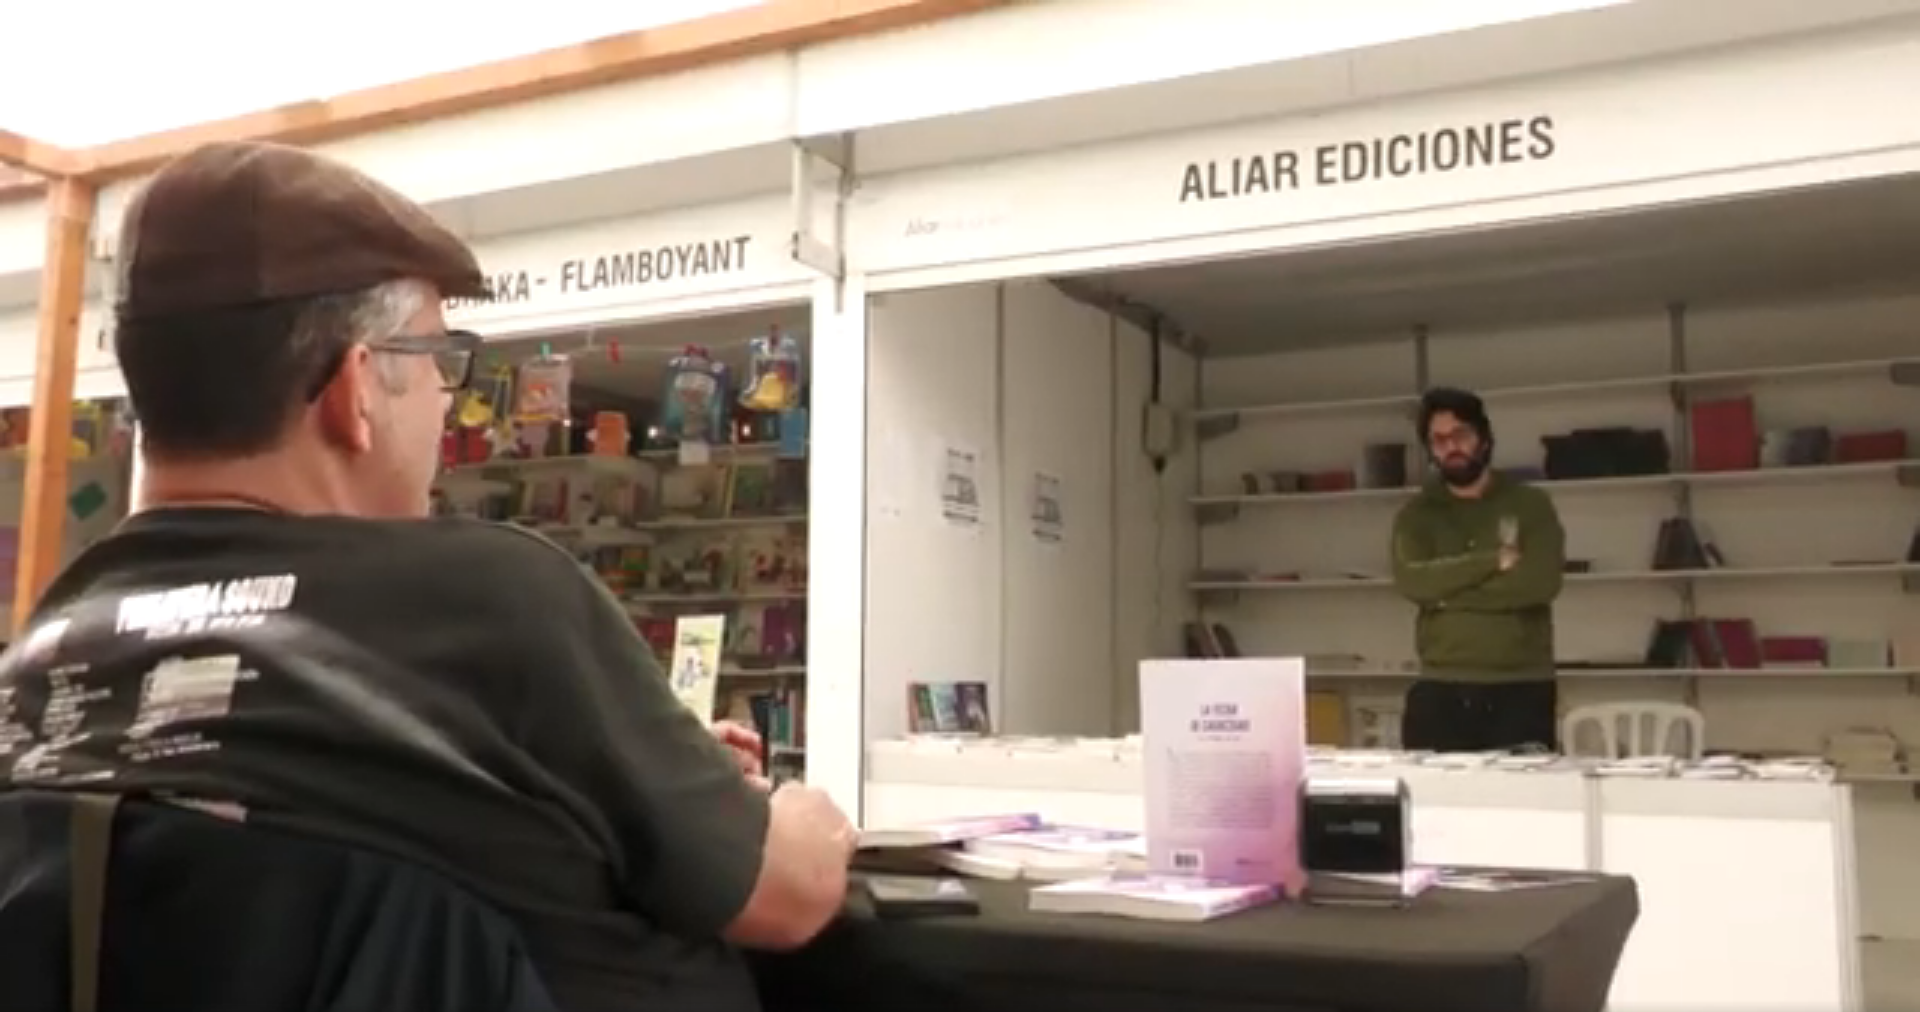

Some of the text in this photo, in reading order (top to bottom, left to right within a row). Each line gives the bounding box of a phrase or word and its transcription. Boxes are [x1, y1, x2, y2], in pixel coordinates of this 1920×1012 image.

[1180, 116, 1555, 202] ALIAR EDICIONES
[560, 235, 752, 293] FLAMBOYANT
